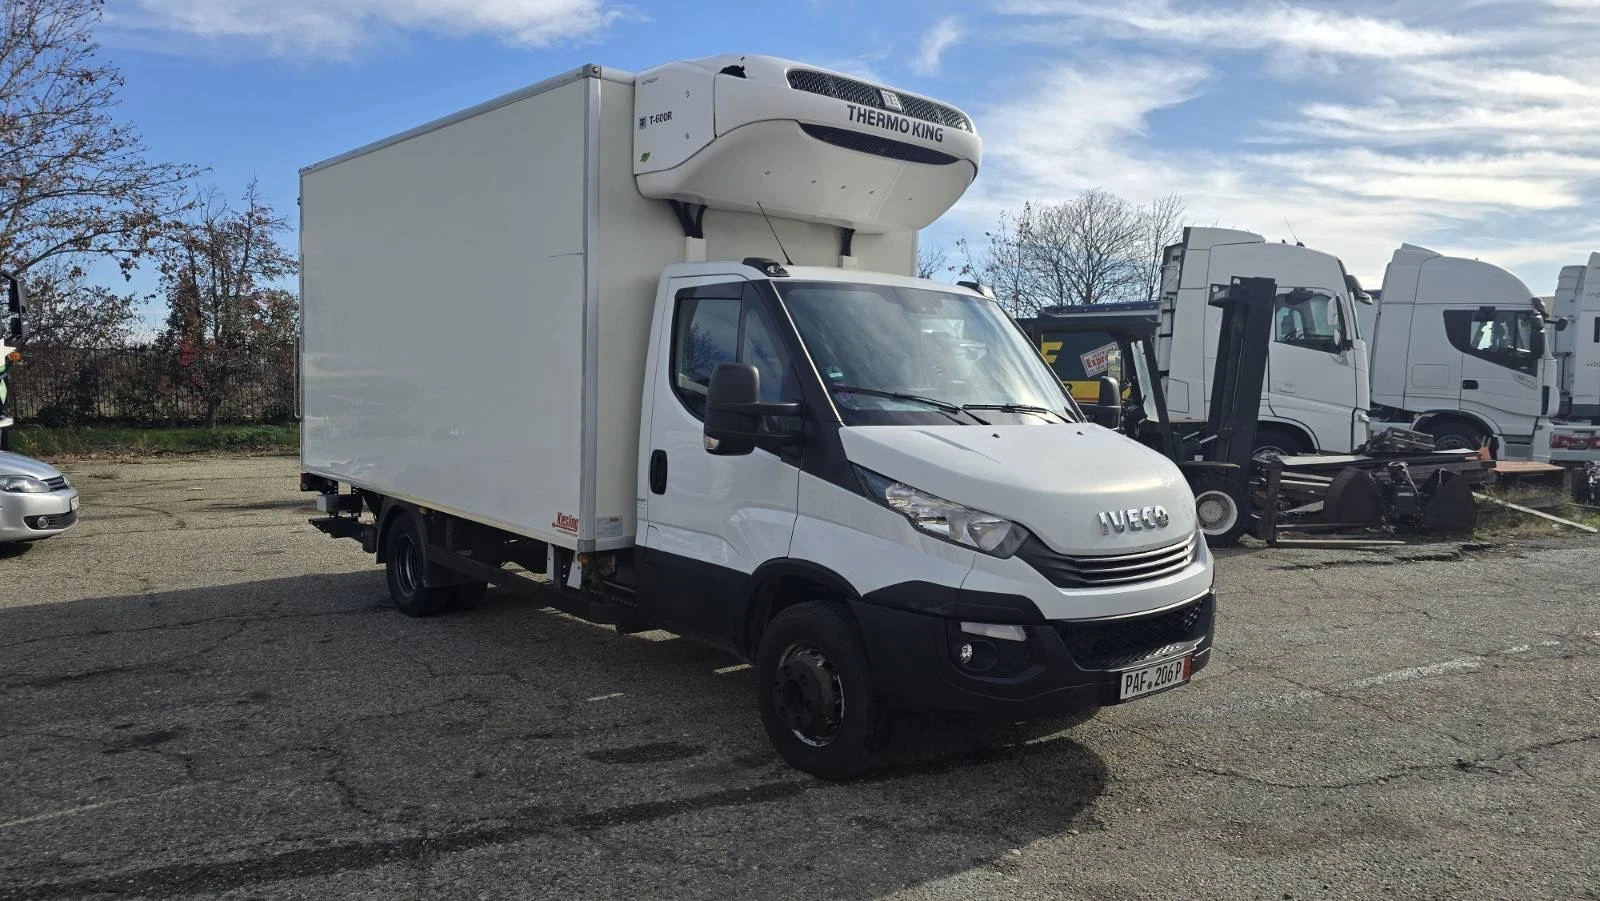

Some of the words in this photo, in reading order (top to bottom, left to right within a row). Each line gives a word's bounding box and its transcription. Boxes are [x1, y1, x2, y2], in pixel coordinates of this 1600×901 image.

[649, 110, 672, 125] T-600R
[847, 103, 910, 133] THERMO
[912, 120, 944, 142] KING
[1098, 505, 1169, 536] IVECO
[1125, 670, 1148, 695] PAF
[1154, 663, 1174, 687] 206
